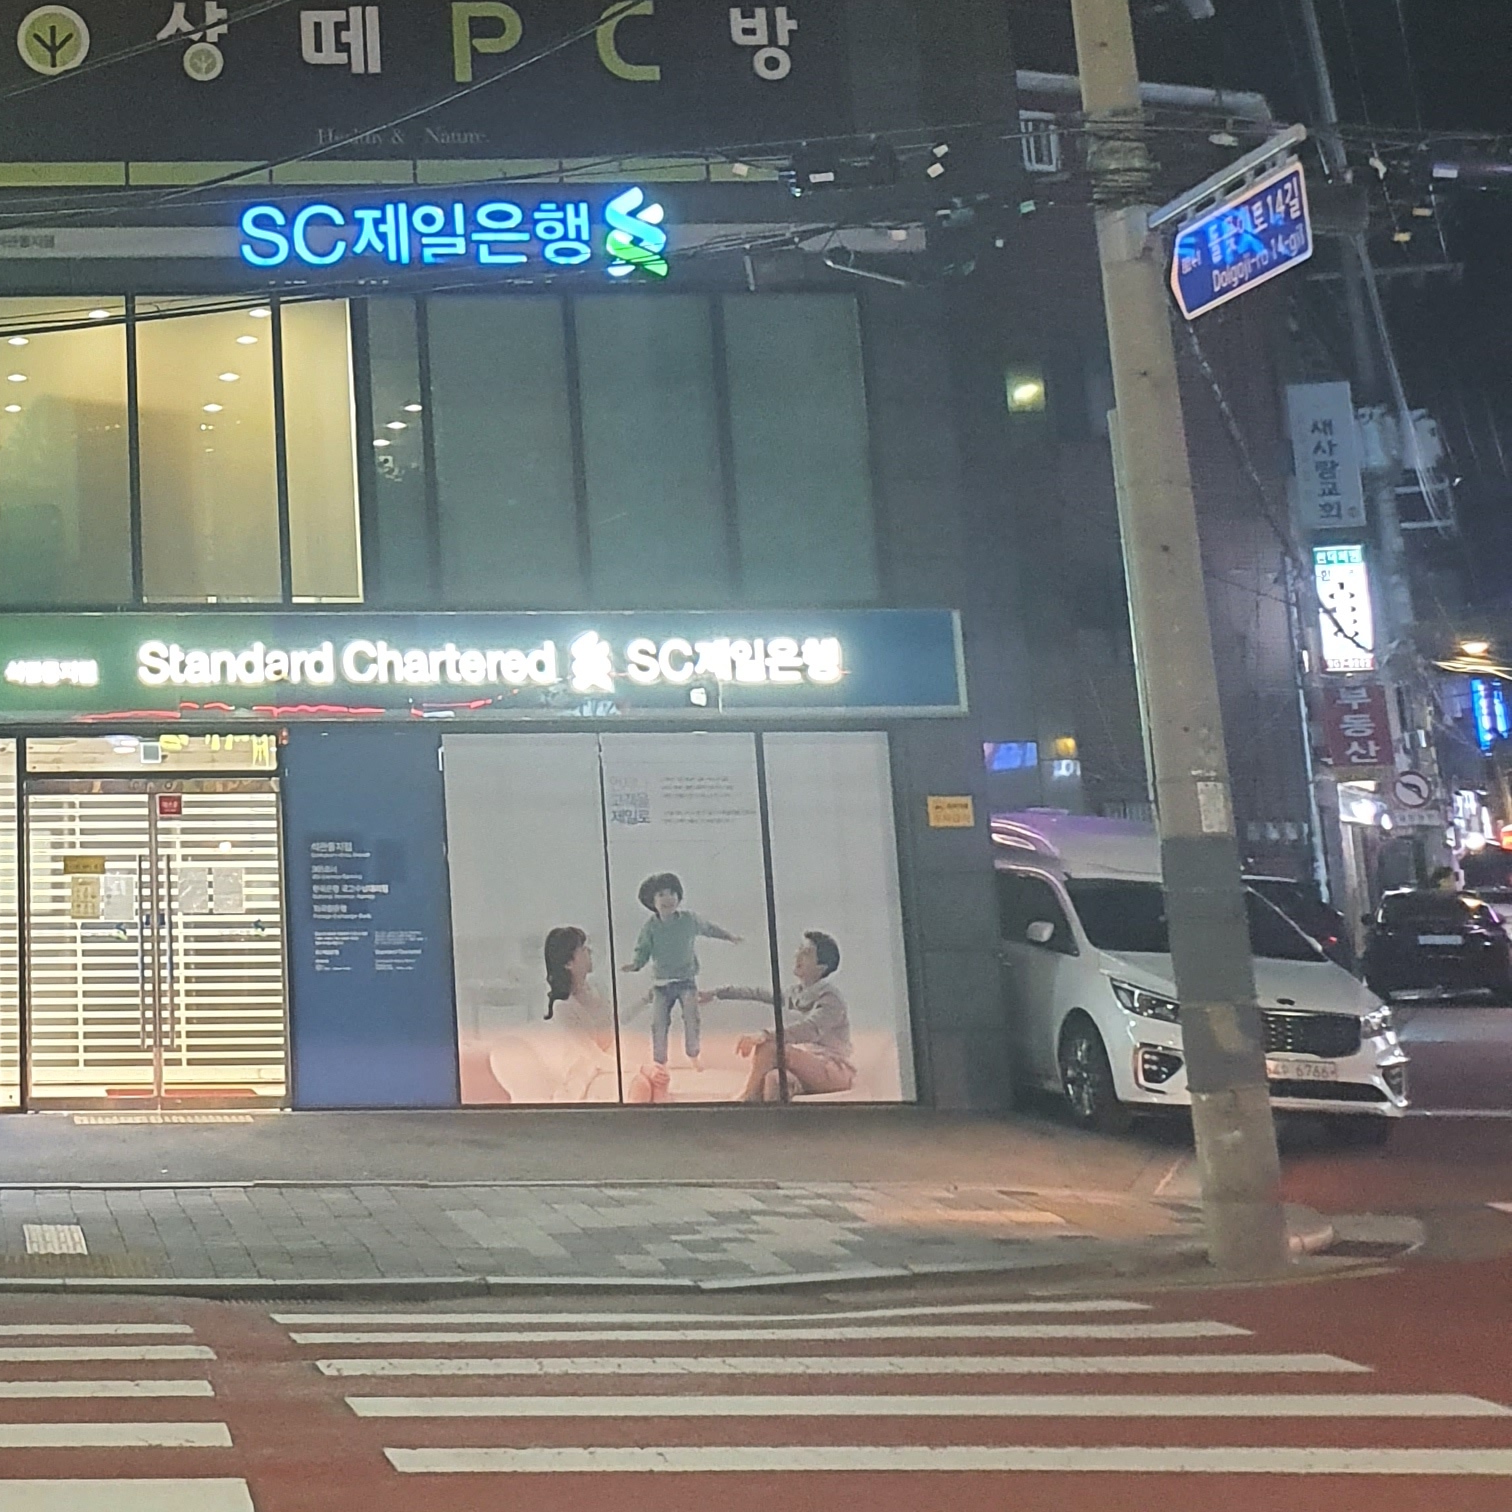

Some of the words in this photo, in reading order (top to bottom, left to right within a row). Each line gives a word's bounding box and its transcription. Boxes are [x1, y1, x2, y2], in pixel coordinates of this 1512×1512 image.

[238, 200, 593, 268] SC제일은행
[1310, 418, 1343, 520] 새사랑교회
[136, 639, 336, 687] Standard
[341, 638, 558, 686] Chartered
[625, 636, 845, 687] SC제일은행
[1337, 686, 1381, 764] 부동산
